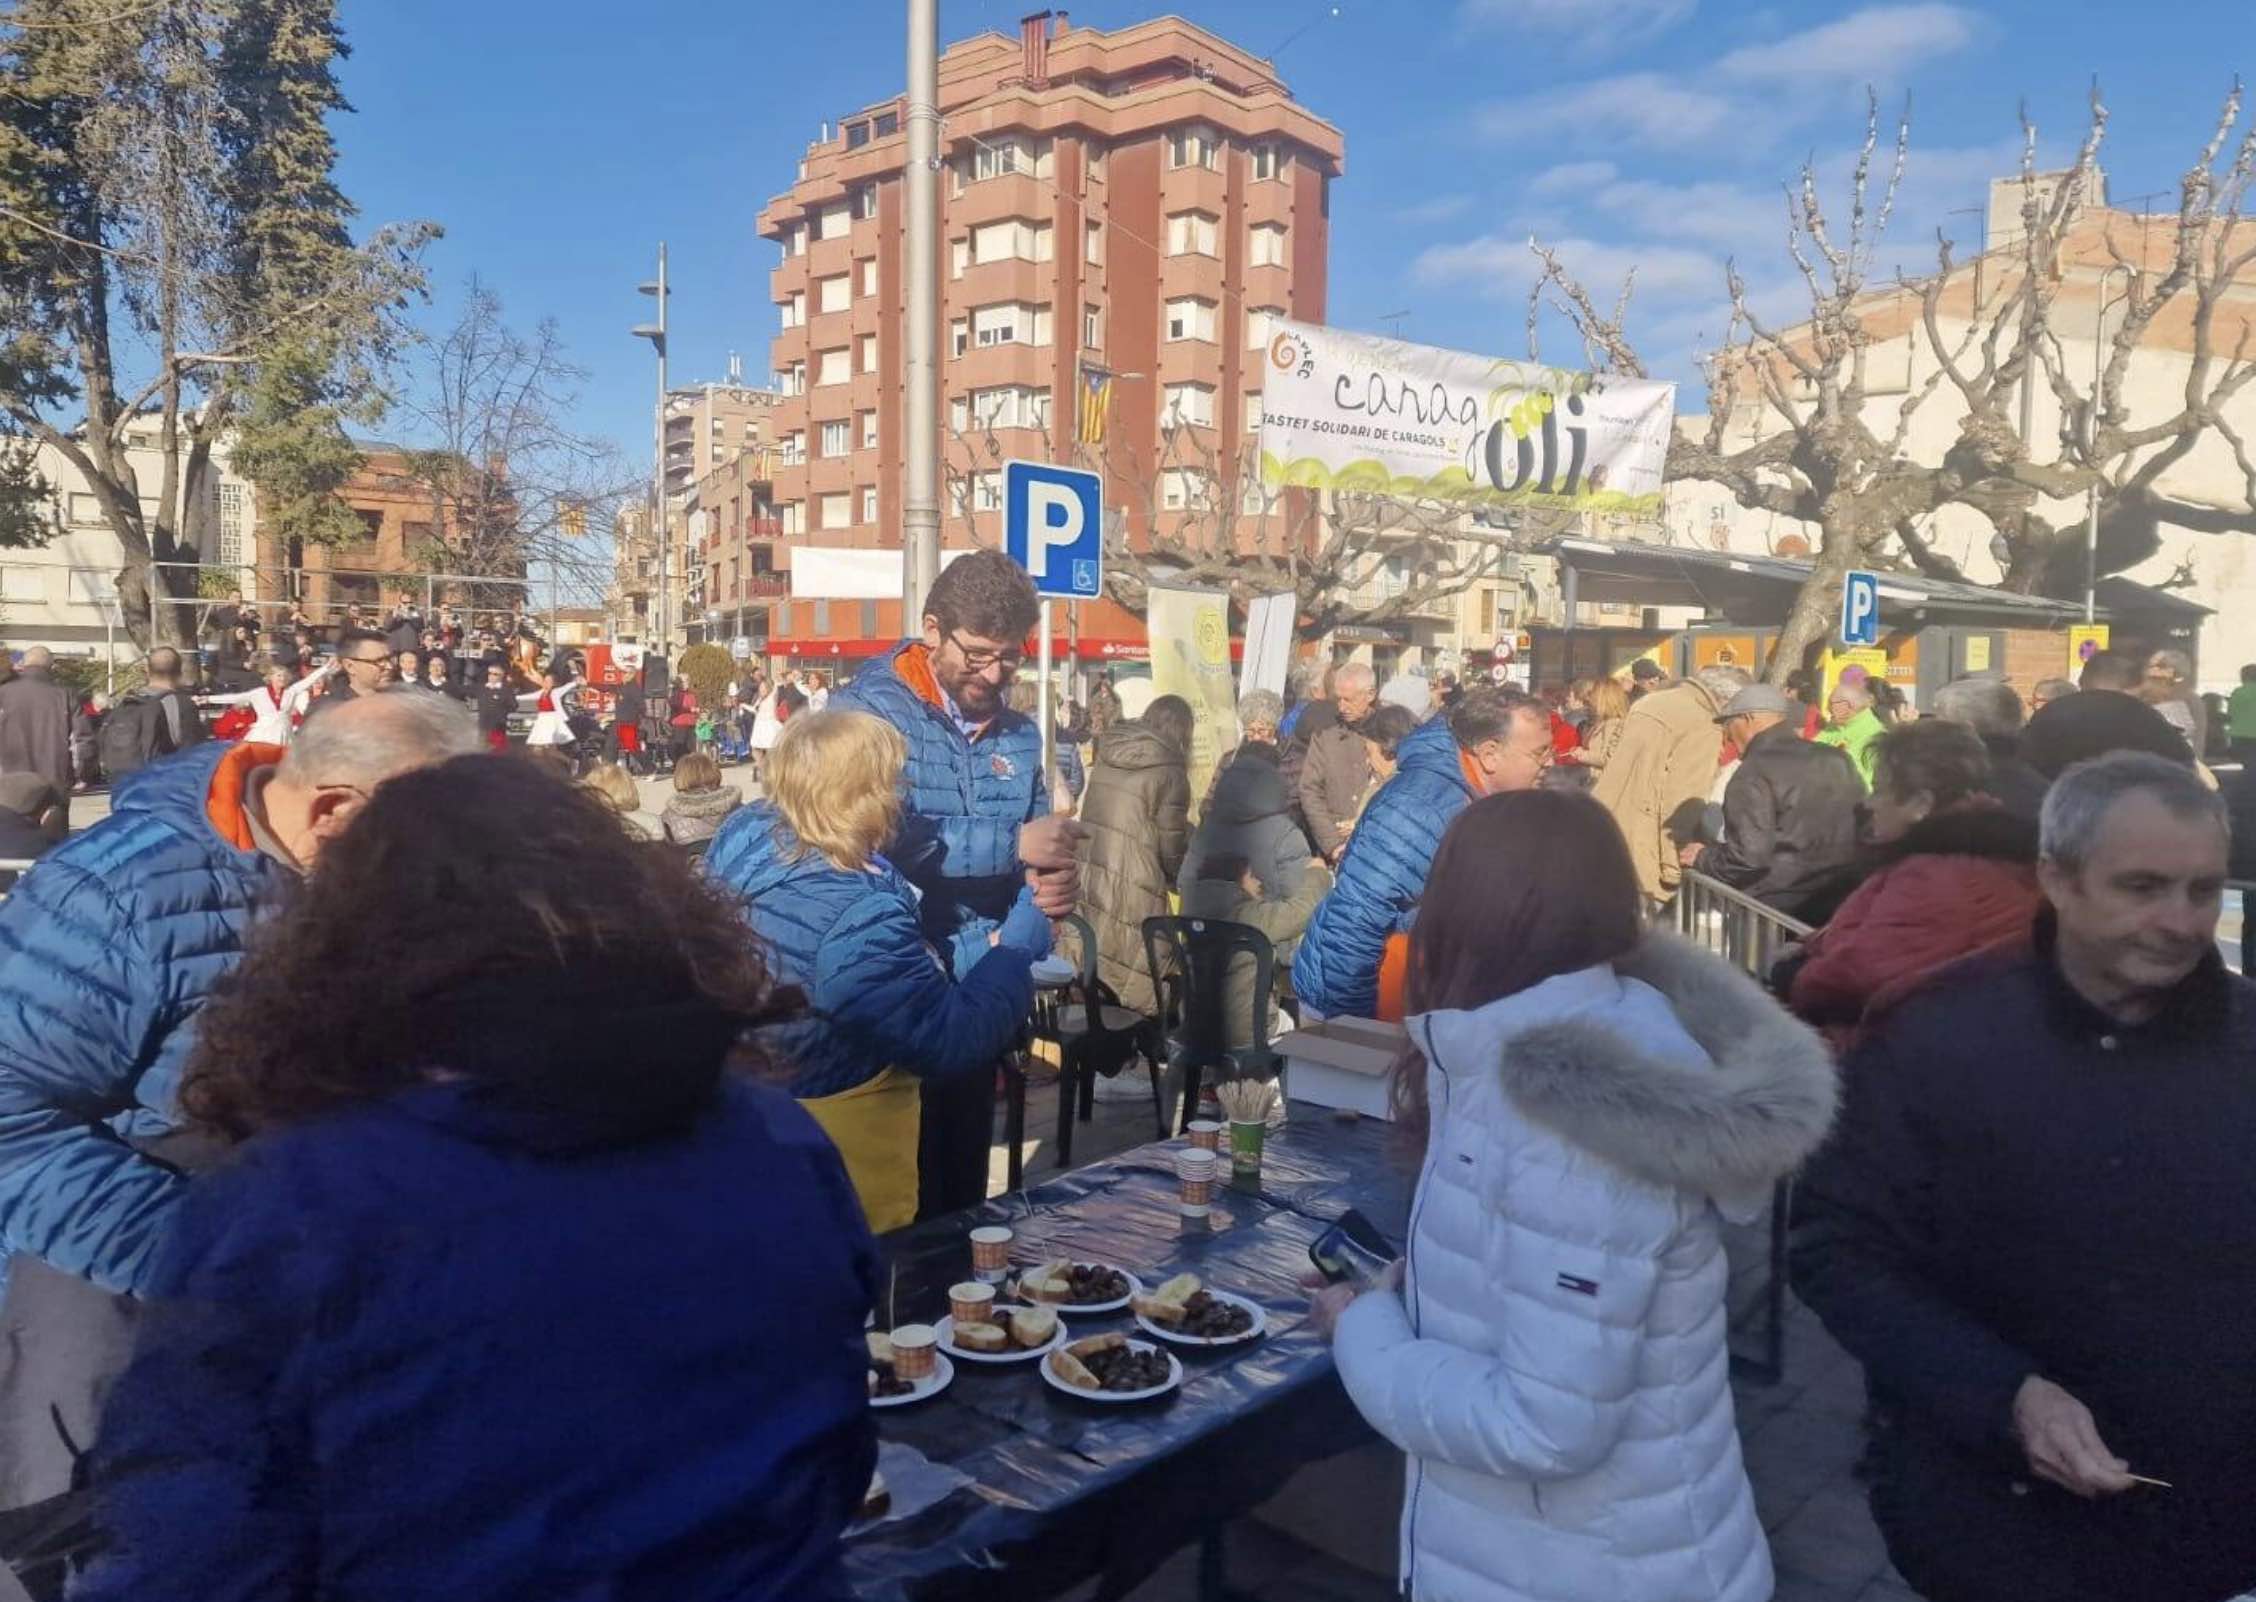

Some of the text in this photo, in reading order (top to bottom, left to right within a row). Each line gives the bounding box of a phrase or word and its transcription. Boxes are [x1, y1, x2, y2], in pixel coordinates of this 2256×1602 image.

[1262, 413, 1447, 448] TASTET SOLIDARI DE CARAGOLS
[1027, 480, 1085, 577] P
[1850, 580, 1873, 635] P
